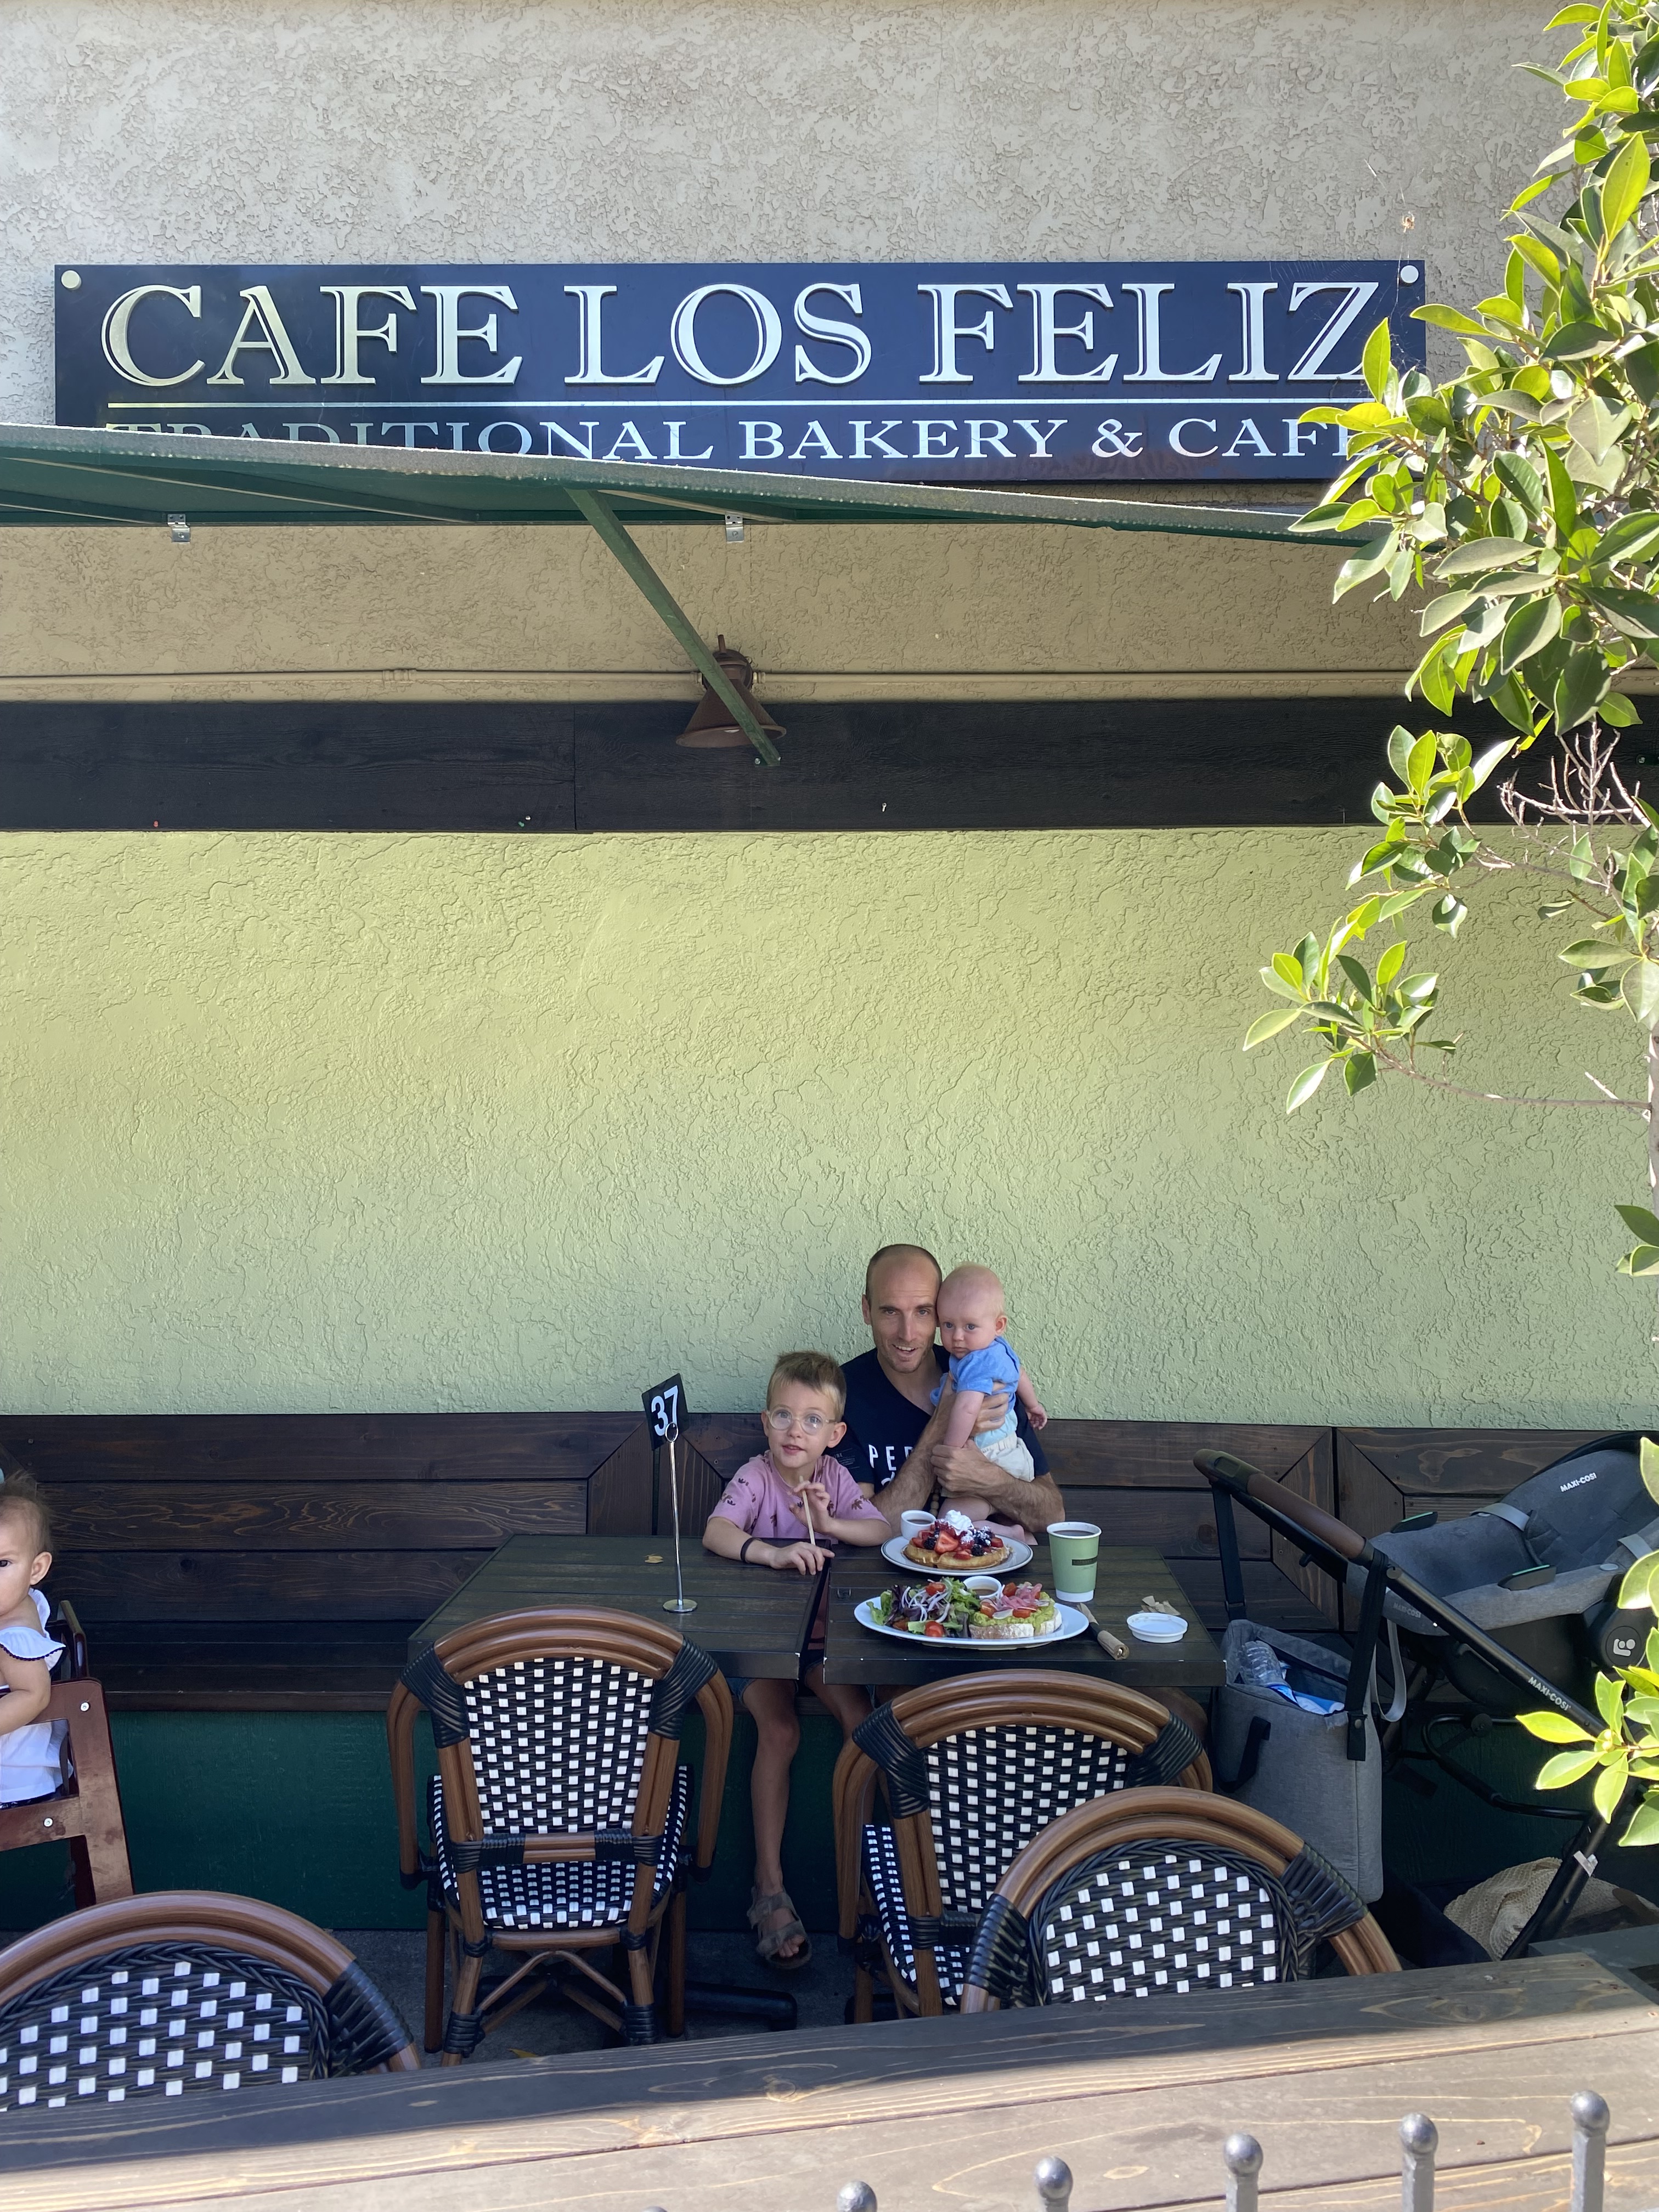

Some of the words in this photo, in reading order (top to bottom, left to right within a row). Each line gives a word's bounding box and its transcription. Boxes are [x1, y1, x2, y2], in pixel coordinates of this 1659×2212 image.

[101, 284, 523, 386] CAFE
[563, 283, 872, 386] LOS
[918, 282, 1379, 384] FELIZ
[738, 419, 1068, 460] BAKERY
[1092, 419, 1144, 458] &
[651, 1385, 678, 1436] 37
